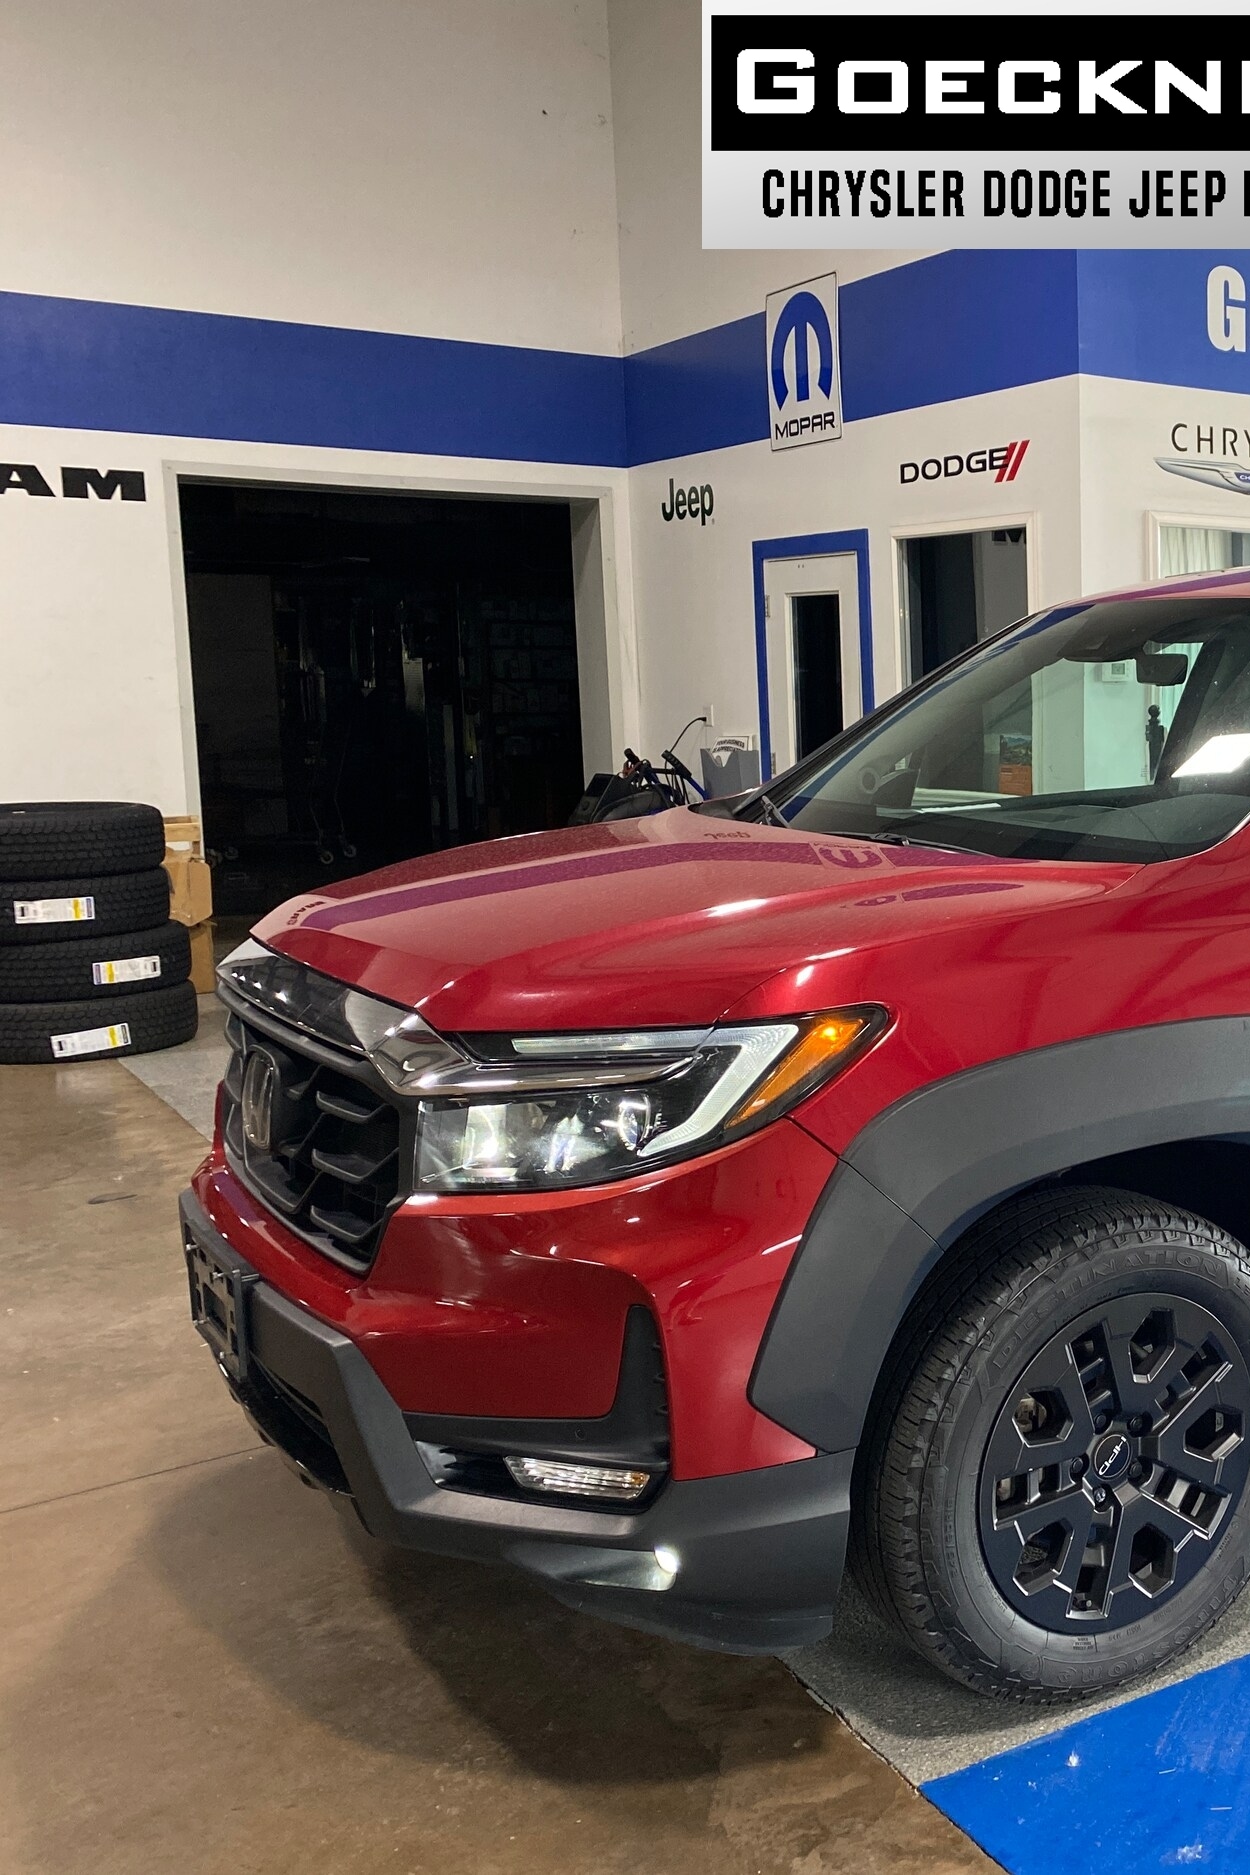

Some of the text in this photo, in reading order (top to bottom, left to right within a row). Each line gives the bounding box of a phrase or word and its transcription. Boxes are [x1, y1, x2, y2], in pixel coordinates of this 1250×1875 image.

[775, 411, 836, 441] MOPAR
[900, 446, 1011, 484] DODGE
[661, 478, 714, 526] Jeep
[1001, 1250, 1223, 1359] DESTINATION
[1057, 1573, 1239, 1684] Firestone
